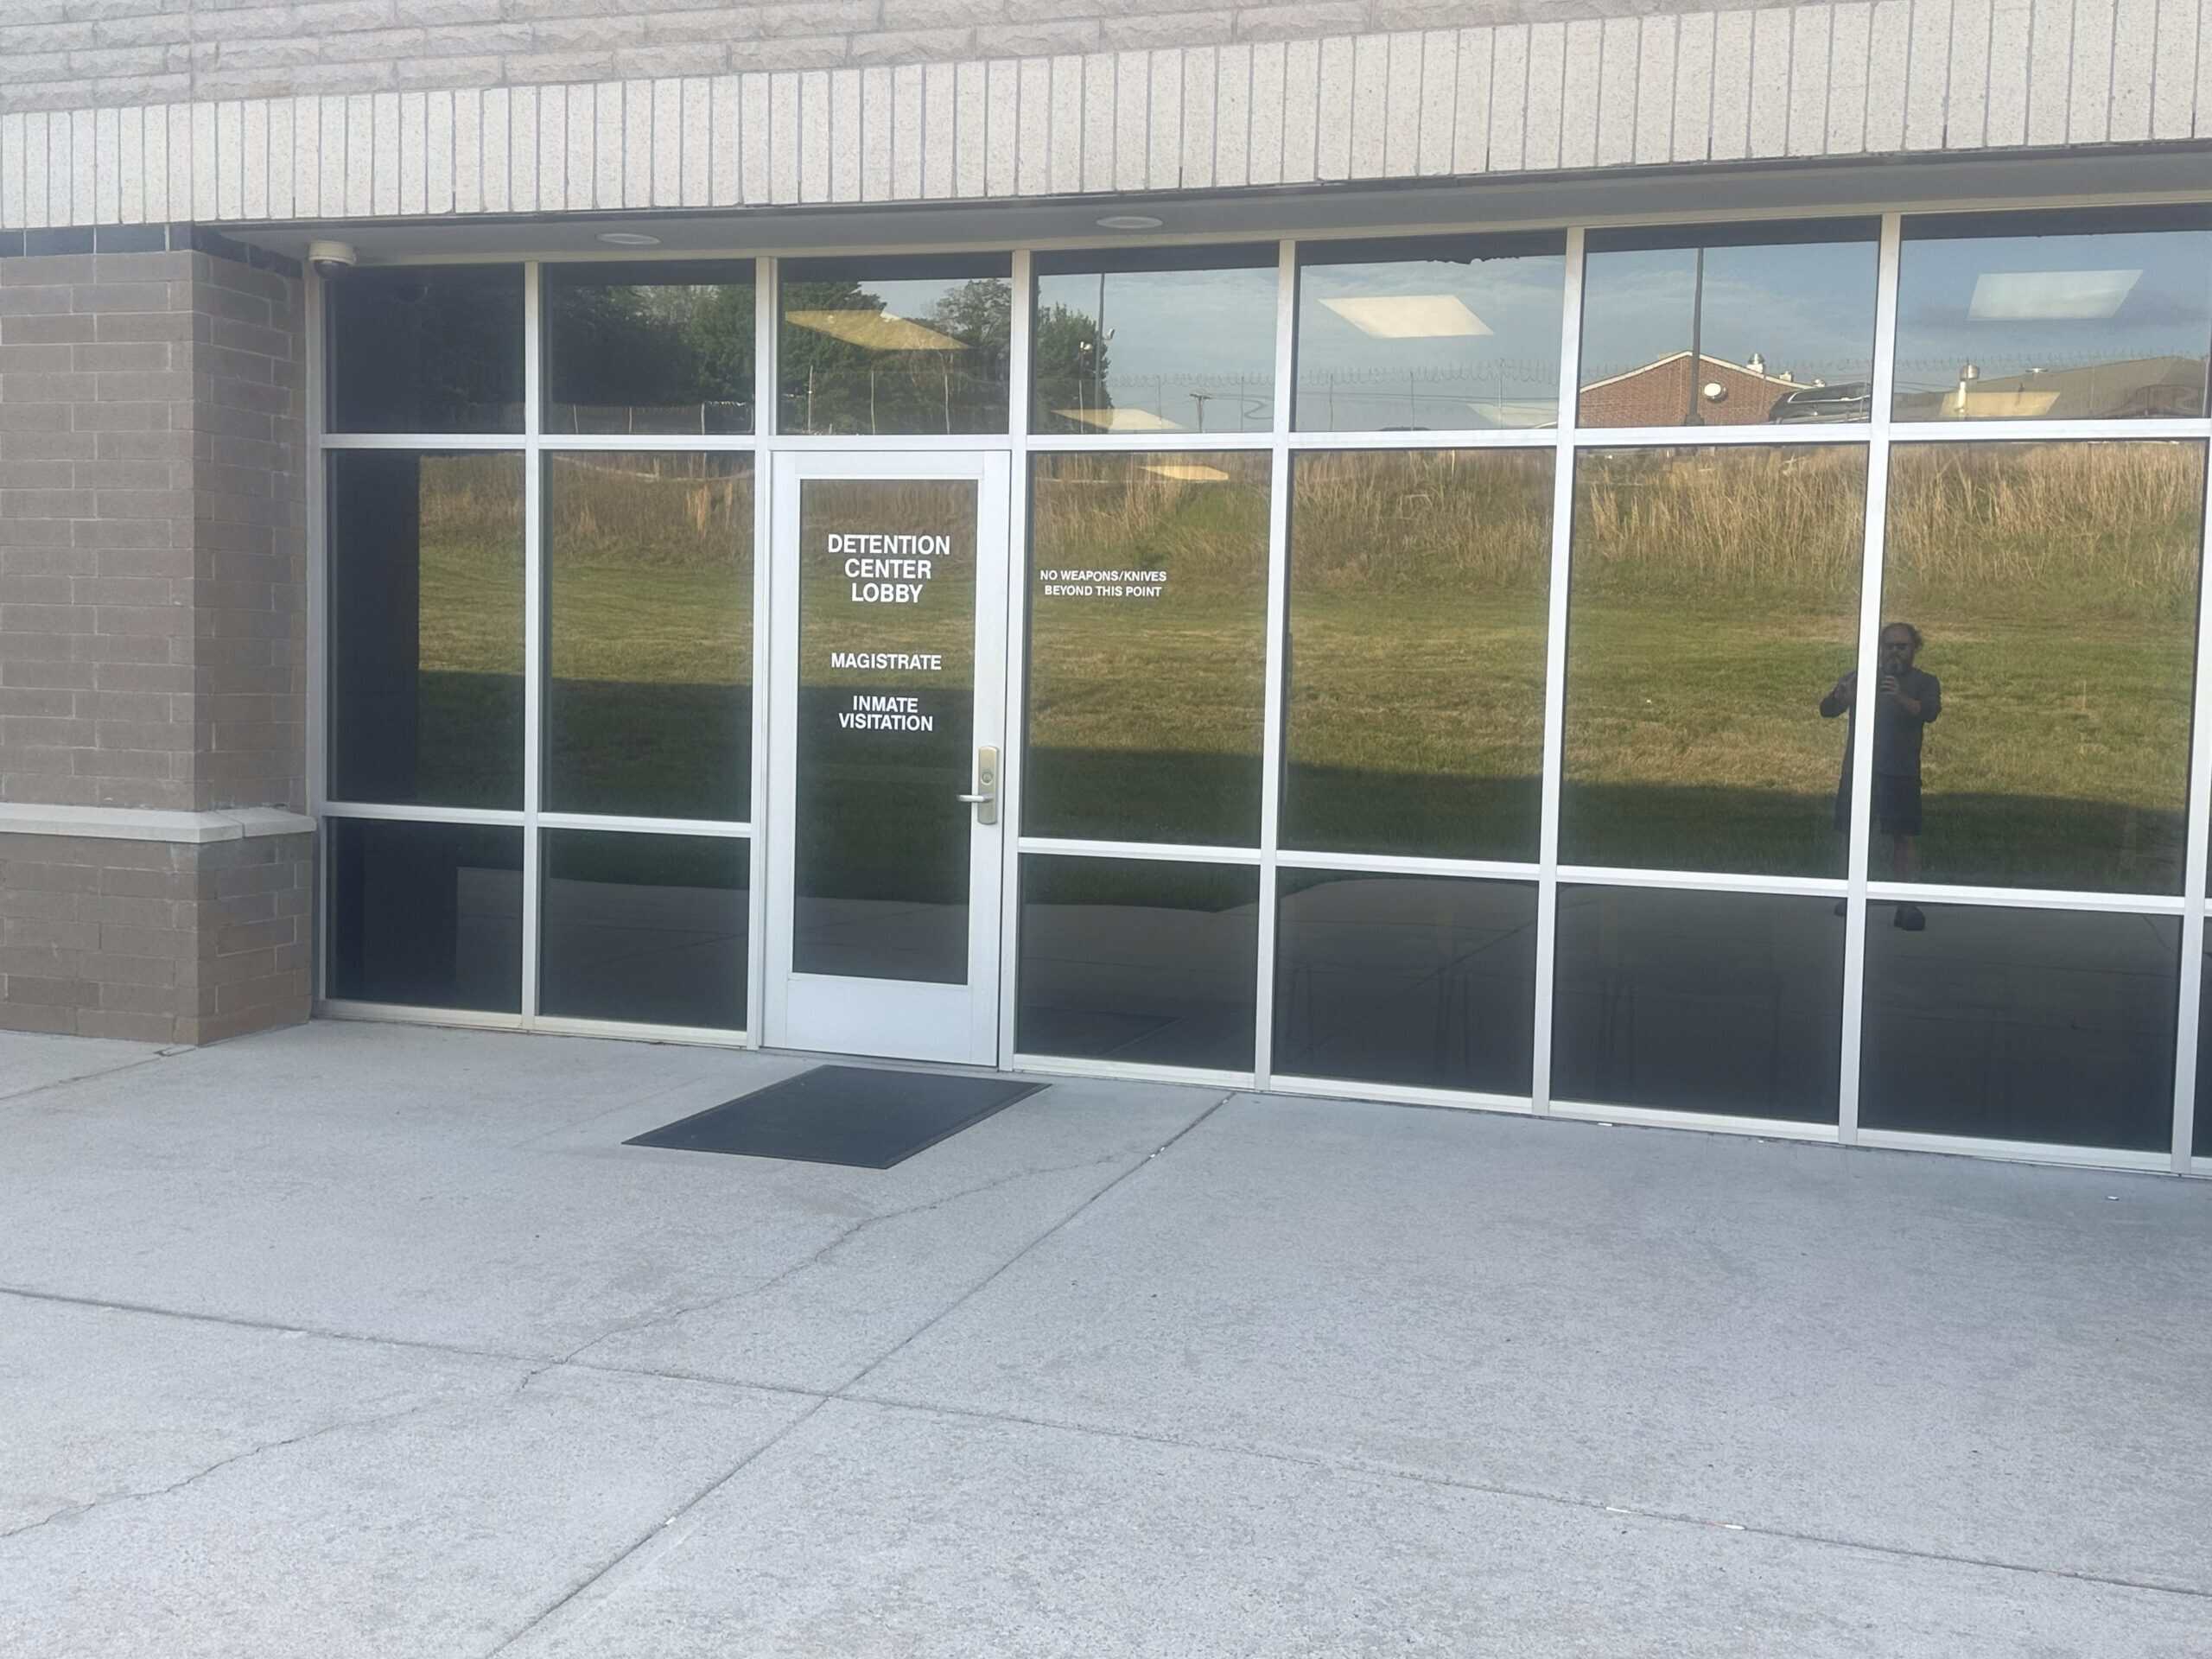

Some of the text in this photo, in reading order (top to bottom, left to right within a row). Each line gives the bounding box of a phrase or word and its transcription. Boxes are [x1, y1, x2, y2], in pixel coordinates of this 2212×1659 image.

[828, 534, 950, 556] DETENTION
[844, 558, 932, 580] CENTER
[1039, 569, 1167, 582] NO WEAPONS/KNIVES
[851, 582, 924, 604] LOBBY
[1044, 585, 1163, 597] BEYOND THIS POINT
[831, 652, 942, 671] MAGISTRATE
[853, 695, 918, 714] INMATE
[838, 713, 933, 732] VISITATION
